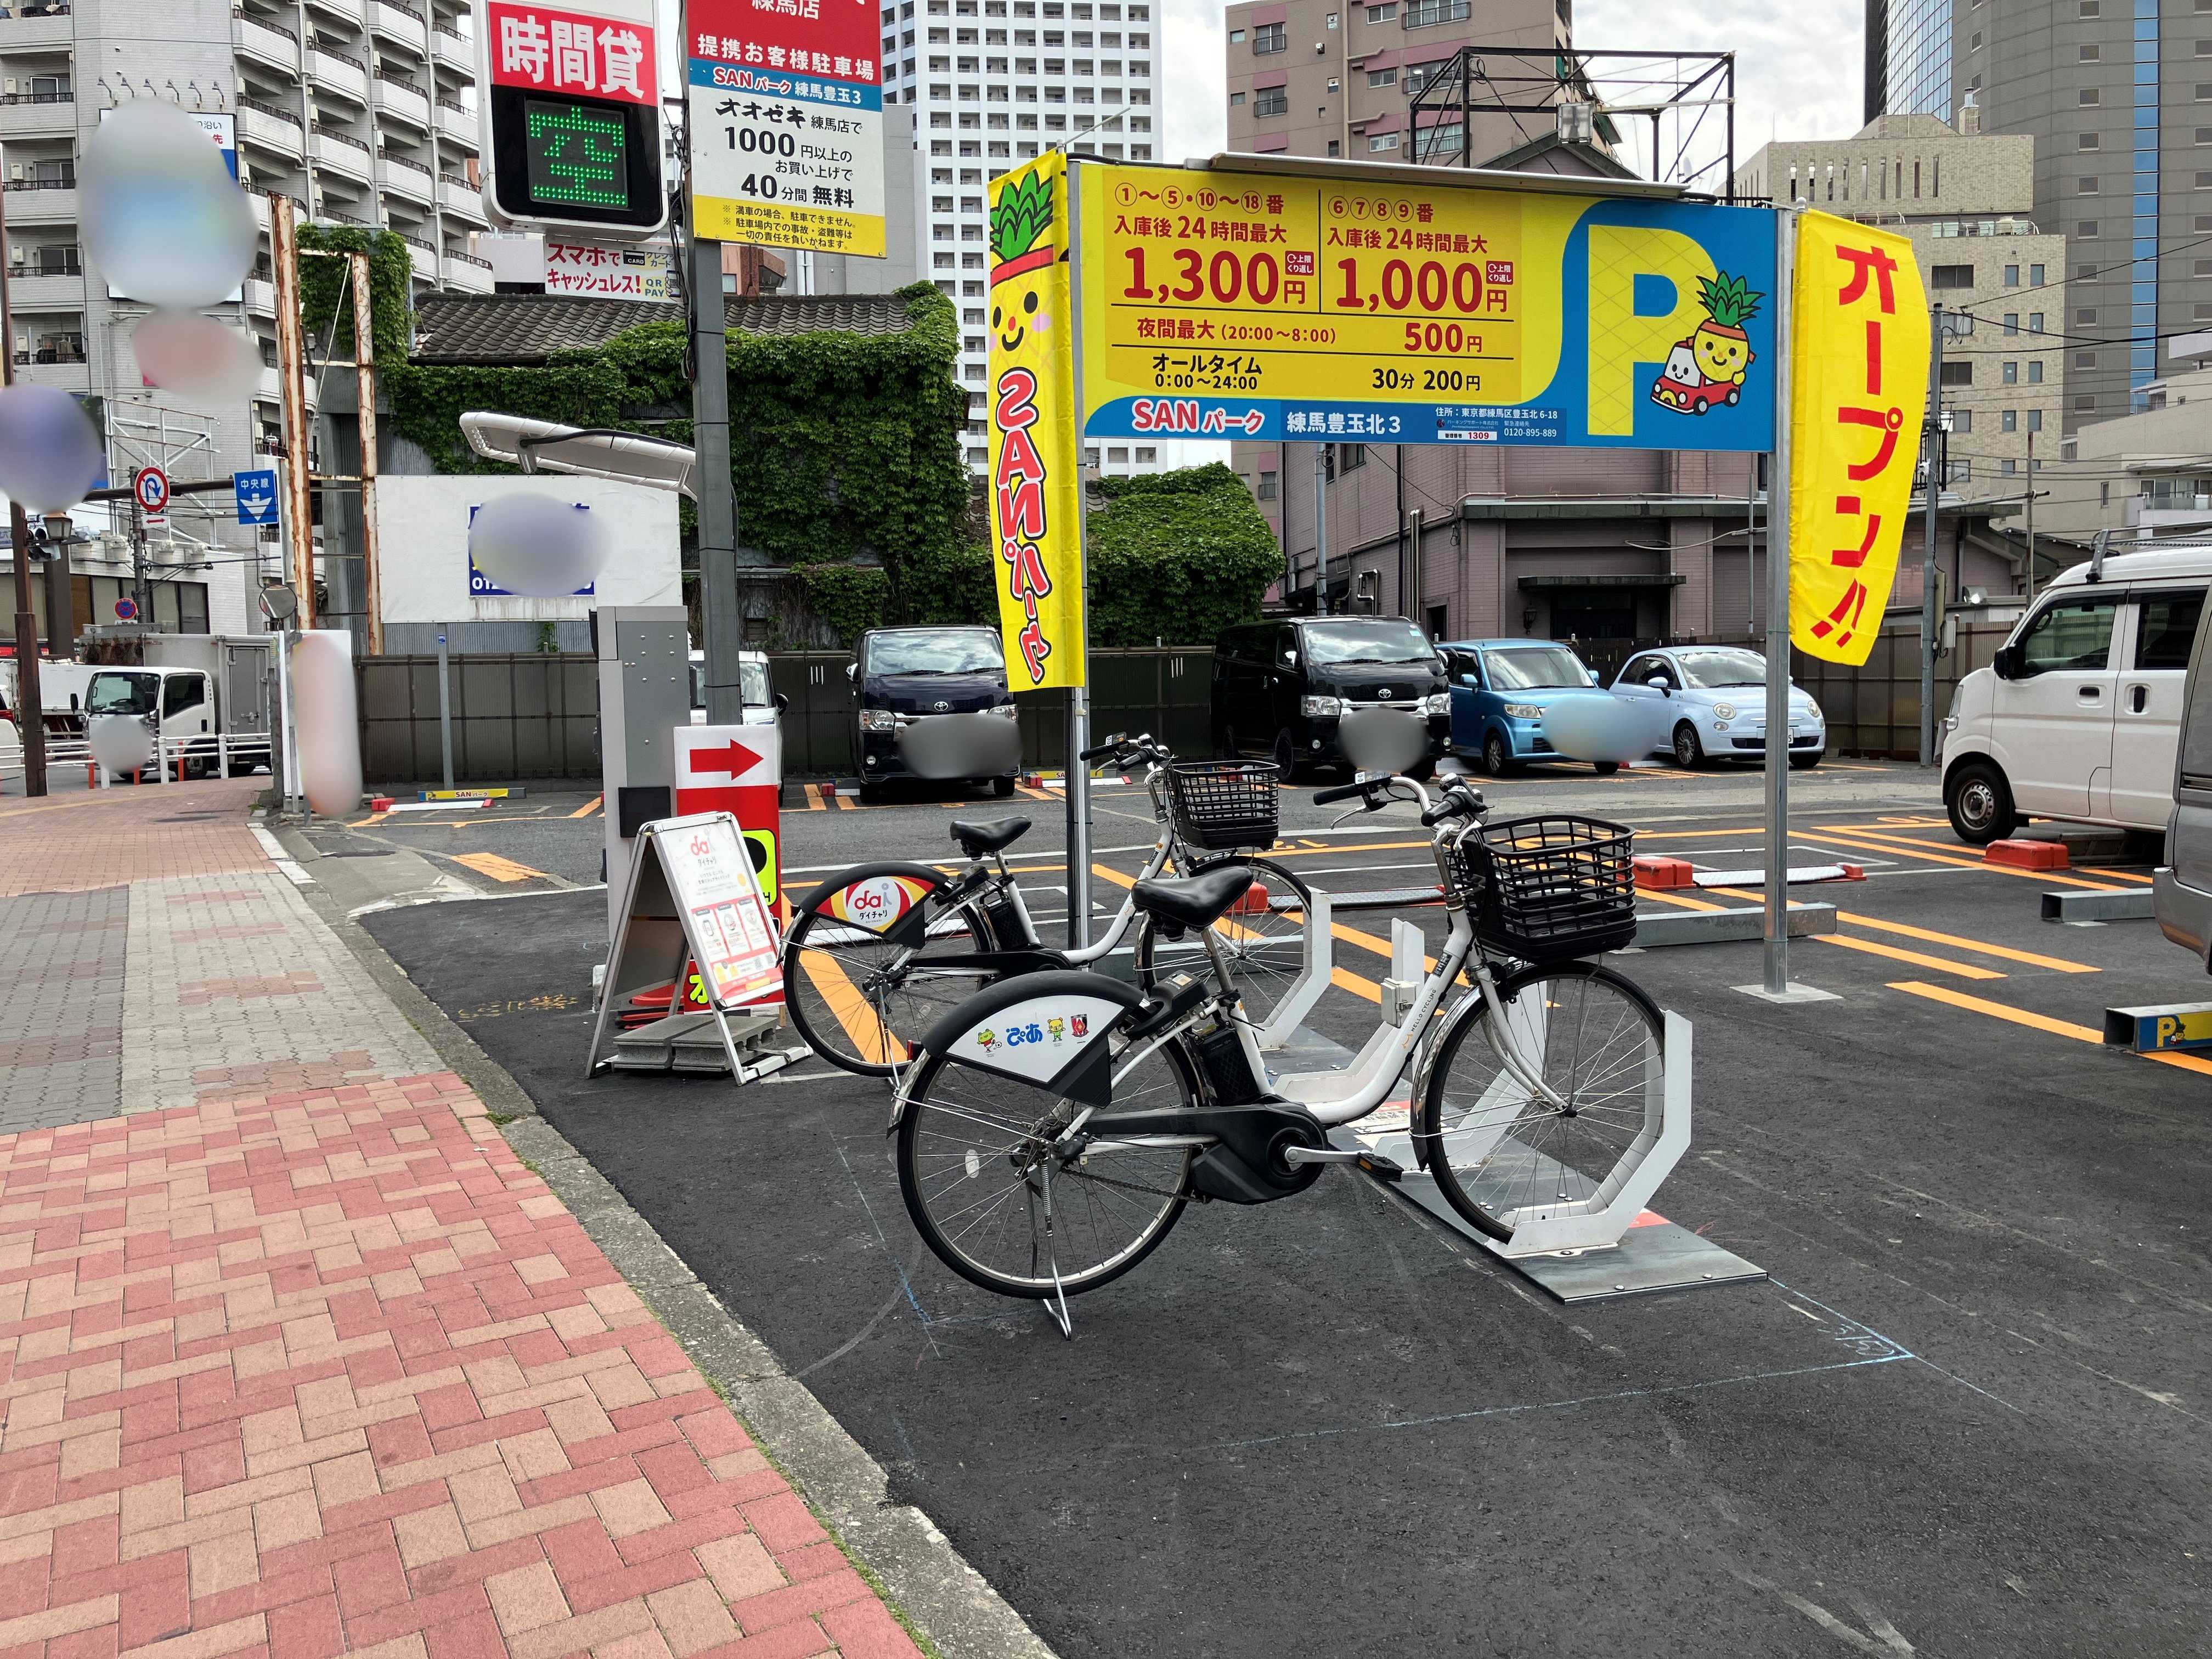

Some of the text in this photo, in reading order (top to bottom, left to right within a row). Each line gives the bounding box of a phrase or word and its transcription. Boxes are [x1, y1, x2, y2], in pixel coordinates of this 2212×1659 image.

[500, 15, 645, 99] 時間貸
[698, 33, 874, 81] 提携お客様駐車場
[795, 81, 861, 104] 練馬豊玉3
[531, 106, 626, 205] 空
[775, 160, 853, 182] お買い上げで
[736, 230, 848, 250] 一切の責任を負いかねます。
[548, 244, 620, 267] スマホで
[651, 259, 671, 268] カード
[1296, 255, 1312, 263] 上限
[1287, 264, 1313, 274] くり返し
[1497, 264, 1511, 273] 上限
[646, 279, 662, 287] QR
[1488, 274, 1512, 283] くり返し
[645, 289, 664, 297] PAY
[1152, 353, 1262, 375] オールタイム
[1287, 411, 1401, 435] 練馬豊玉北3
[1504, 428, 1557, 438] 0120-895-889
[240, 477, 269, 490] 中央線
[859, 910, 888, 921] ダイチャリ
[1410, 989, 1437, 1032] HELLO CYCLING
